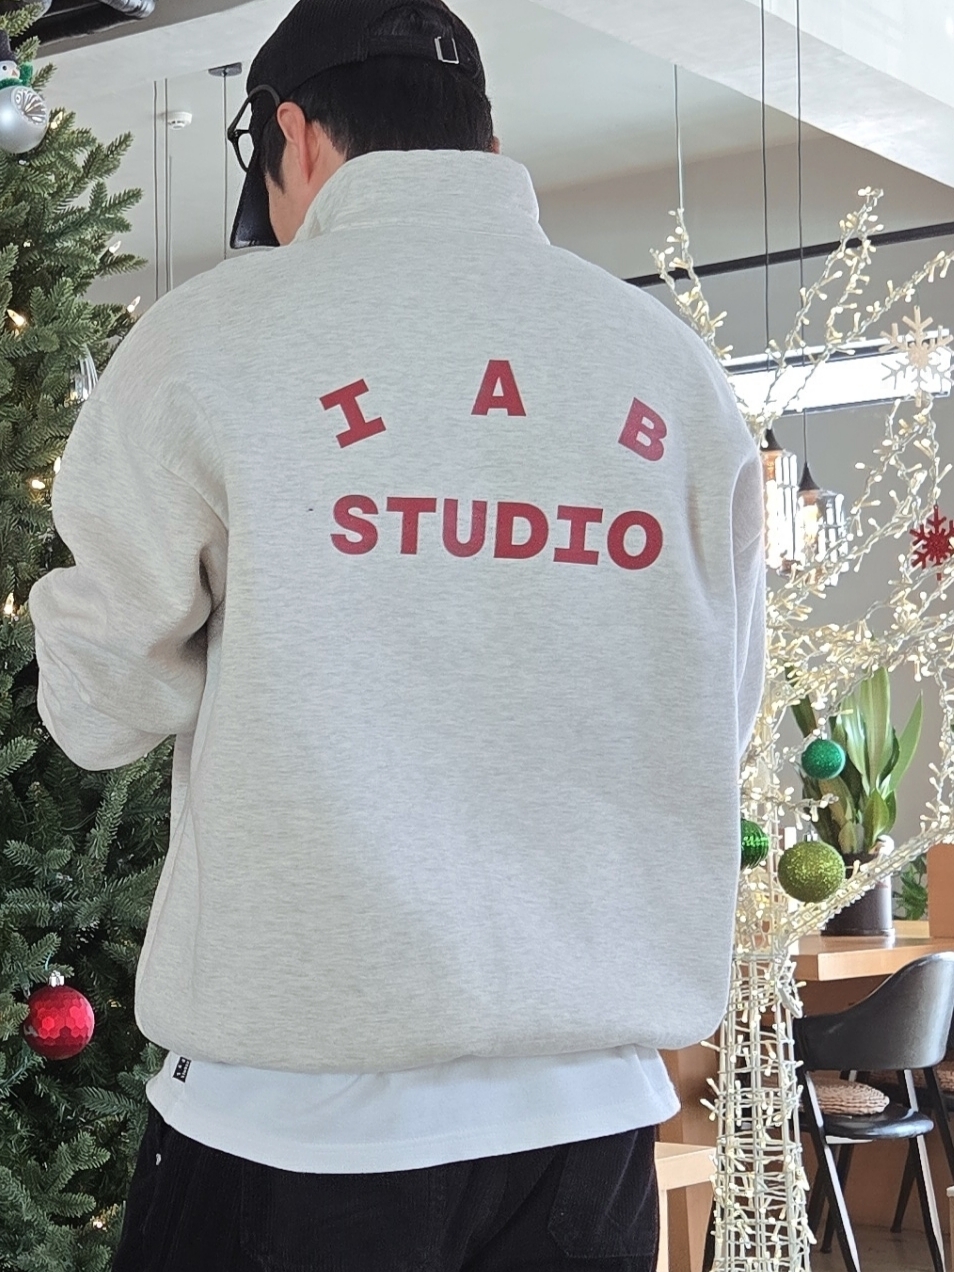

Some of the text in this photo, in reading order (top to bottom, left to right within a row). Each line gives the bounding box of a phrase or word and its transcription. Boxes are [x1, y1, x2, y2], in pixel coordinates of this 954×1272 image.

[319, 359, 668, 462] I A B
[330, 494, 664, 570] STUDIO
